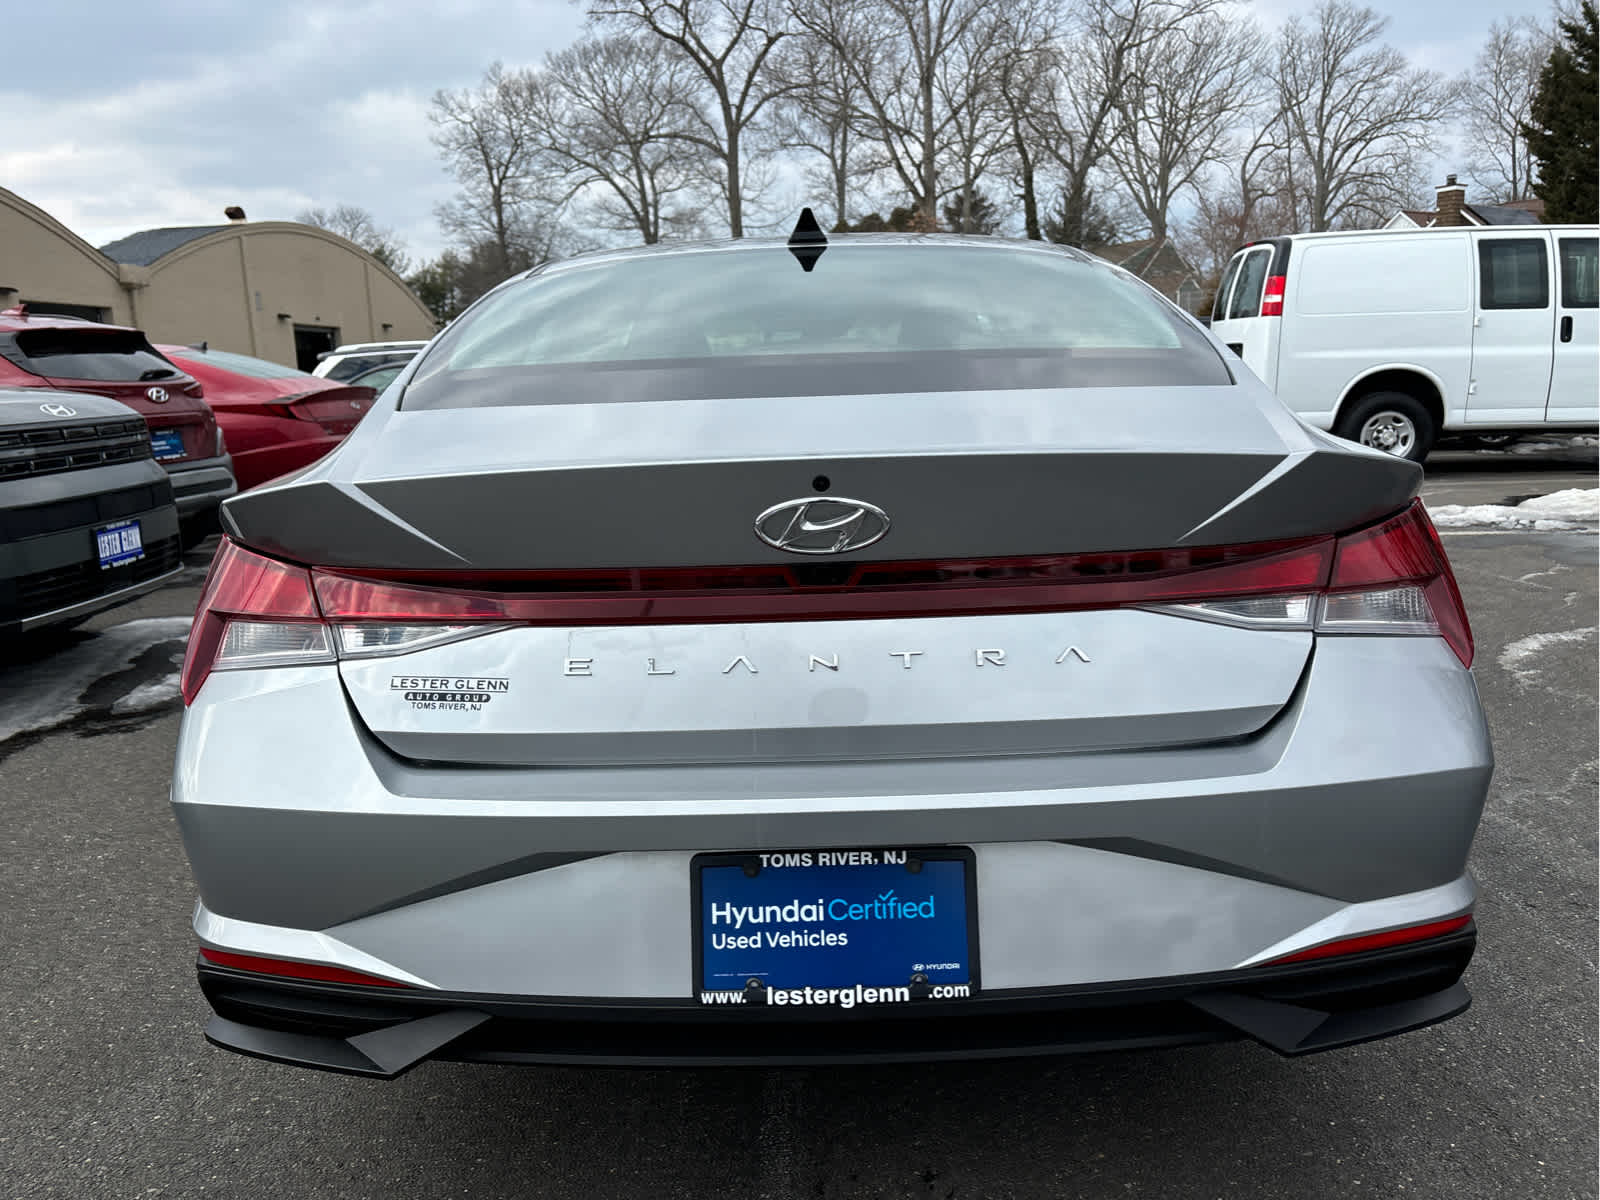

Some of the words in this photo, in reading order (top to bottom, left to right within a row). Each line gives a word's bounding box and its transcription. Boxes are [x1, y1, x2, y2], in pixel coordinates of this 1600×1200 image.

[563, 645, 1092, 677] ELANTRA
[391, 679, 449, 689] LESTER
[455, 680, 509, 691] GLENN
[407, 693, 440, 701] AUTO
[446, 694, 488, 702] GROUP
[412, 702, 436, 710] TOMS
[439, 703, 469, 712] RIVER,
[760, 853, 813, 868] TOMS
[818, 852, 879, 867] RIVER,
[884, 851, 908, 865] NJ
[711, 899, 825, 929] Hyundai
[828, 893, 935, 921] Certified
[712, 932, 762, 950] Used
[765, 930, 848, 948] Vehicles
[926, 962, 960, 971] HYUNDAI
[701, 991, 747, 1005] www.
[767, 985, 910, 1008] lesterglenn
[928, 985, 970, 999] .com
